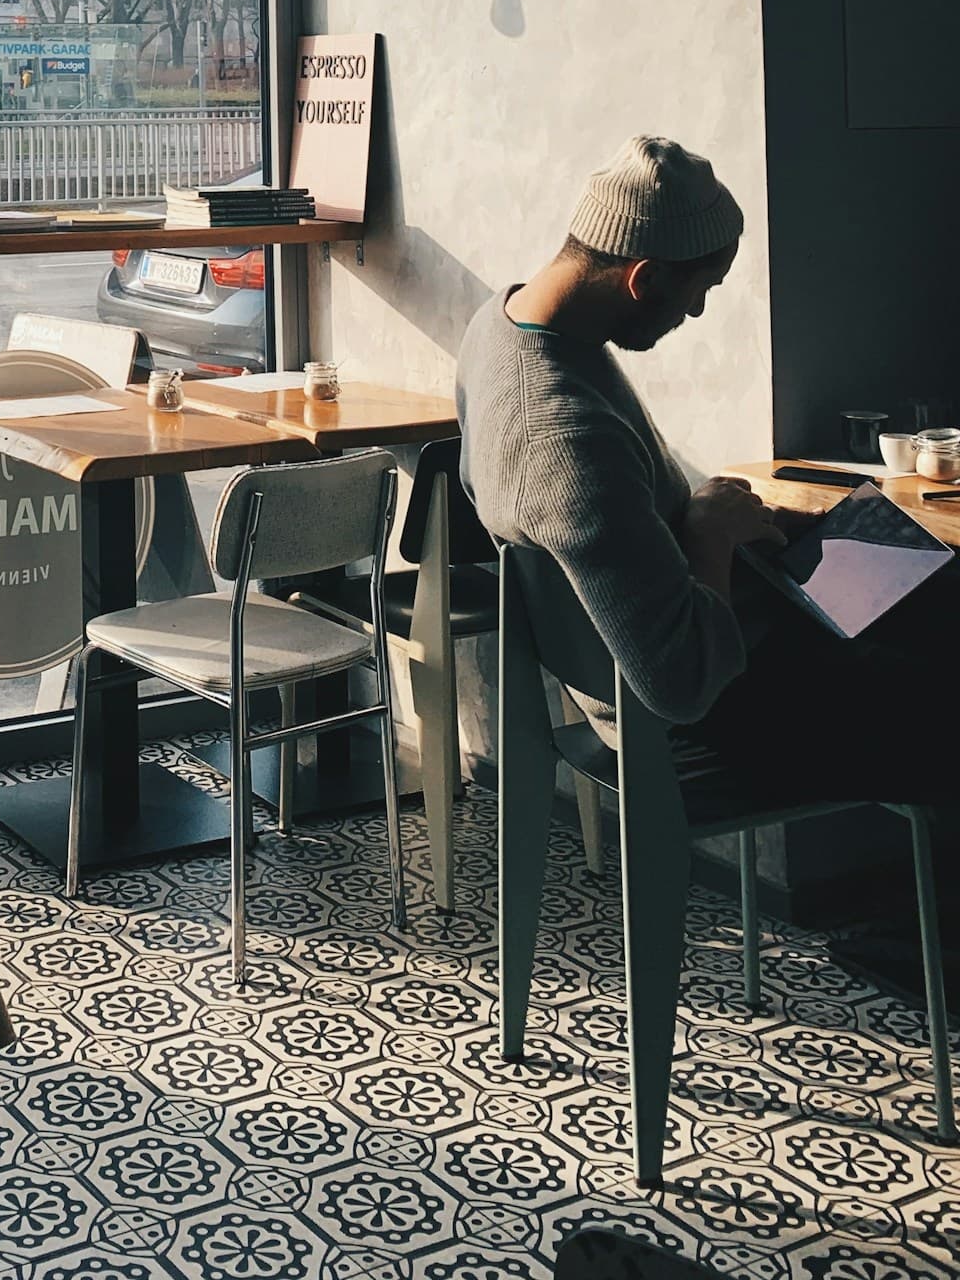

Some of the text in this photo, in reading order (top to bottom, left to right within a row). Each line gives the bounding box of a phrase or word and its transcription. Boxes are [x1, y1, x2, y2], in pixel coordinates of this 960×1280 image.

[56, 60, 86, 73] Budget
[299, 54, 368, 80] ESPRESSO
[296, 100, 366, 125] YOURSELF
